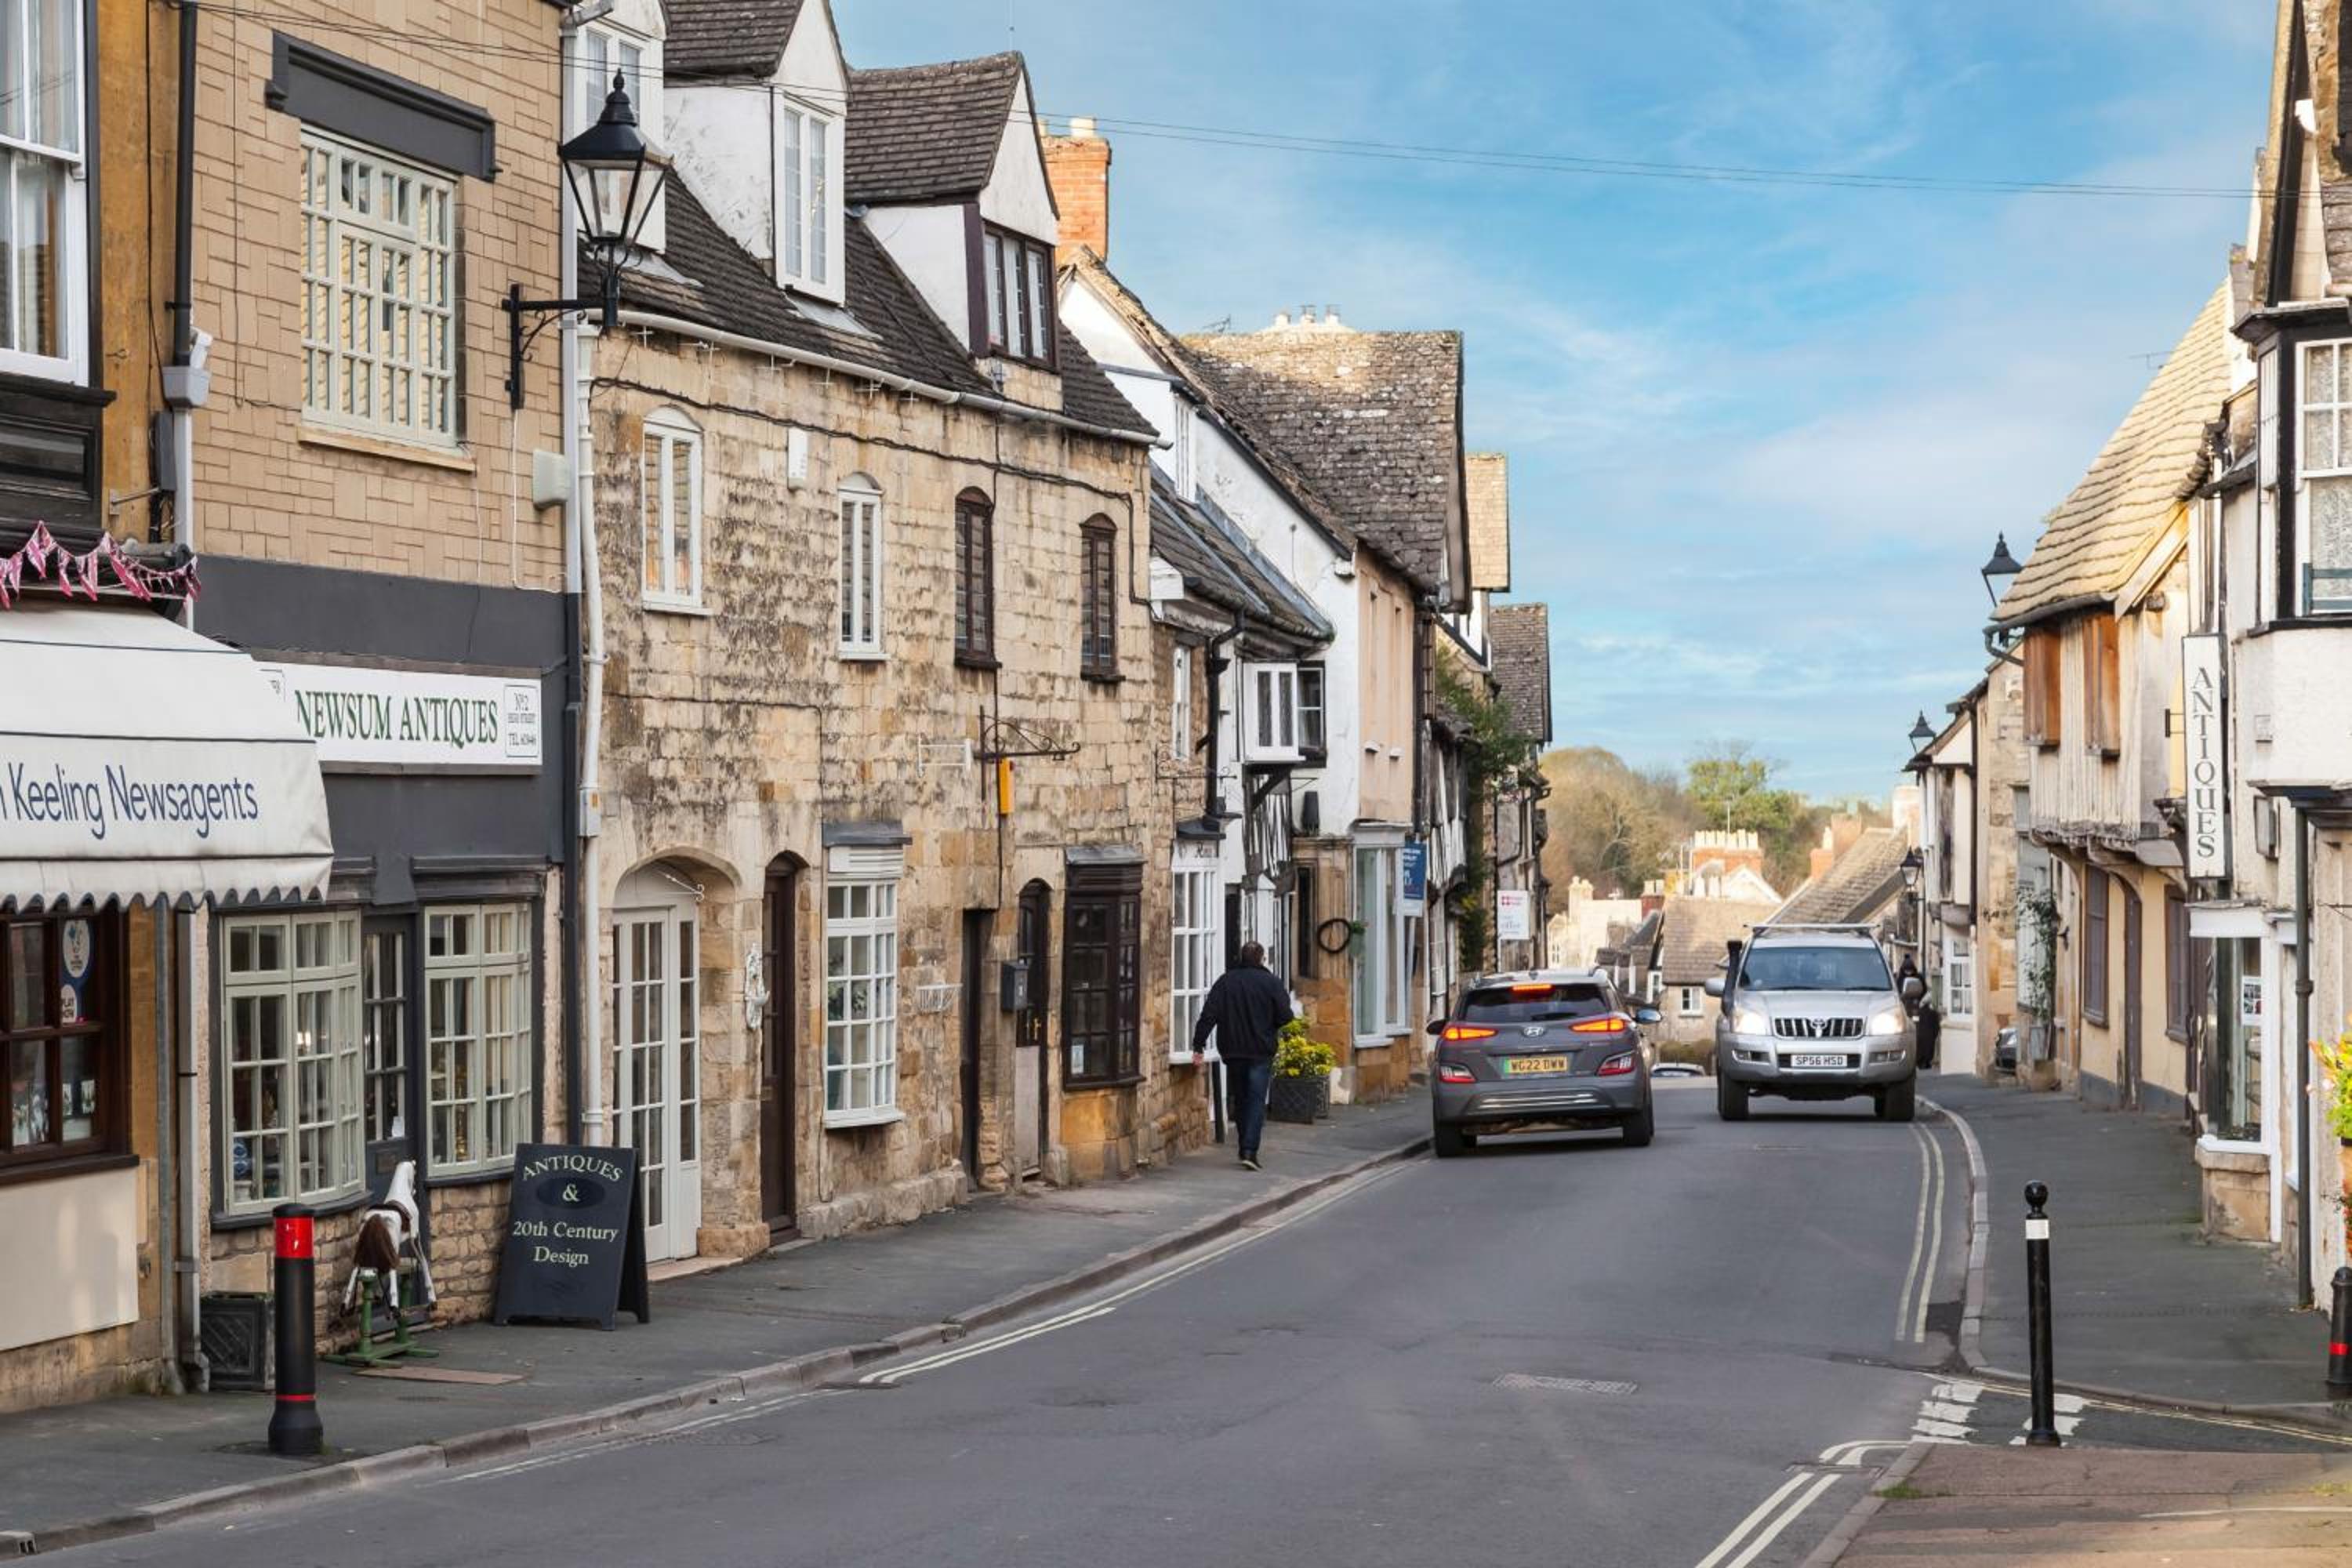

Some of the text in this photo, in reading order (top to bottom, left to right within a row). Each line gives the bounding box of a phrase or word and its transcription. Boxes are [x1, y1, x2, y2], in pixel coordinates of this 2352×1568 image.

[294, 689, 499, 750] NEWSUM ANTIQUES
[2192, 666, 2216, 858] ANTIQUES
[8, 762, 106, 840] Keeling
[105, 764, 259, 839] Newsagents
[522, 1155, 623, 1181] ANTIQUES
[562, 1183, 580, 1202] &
[512, 1221, 619, 1243] 20th Century
[533, 1246, 590, 1268] Design
